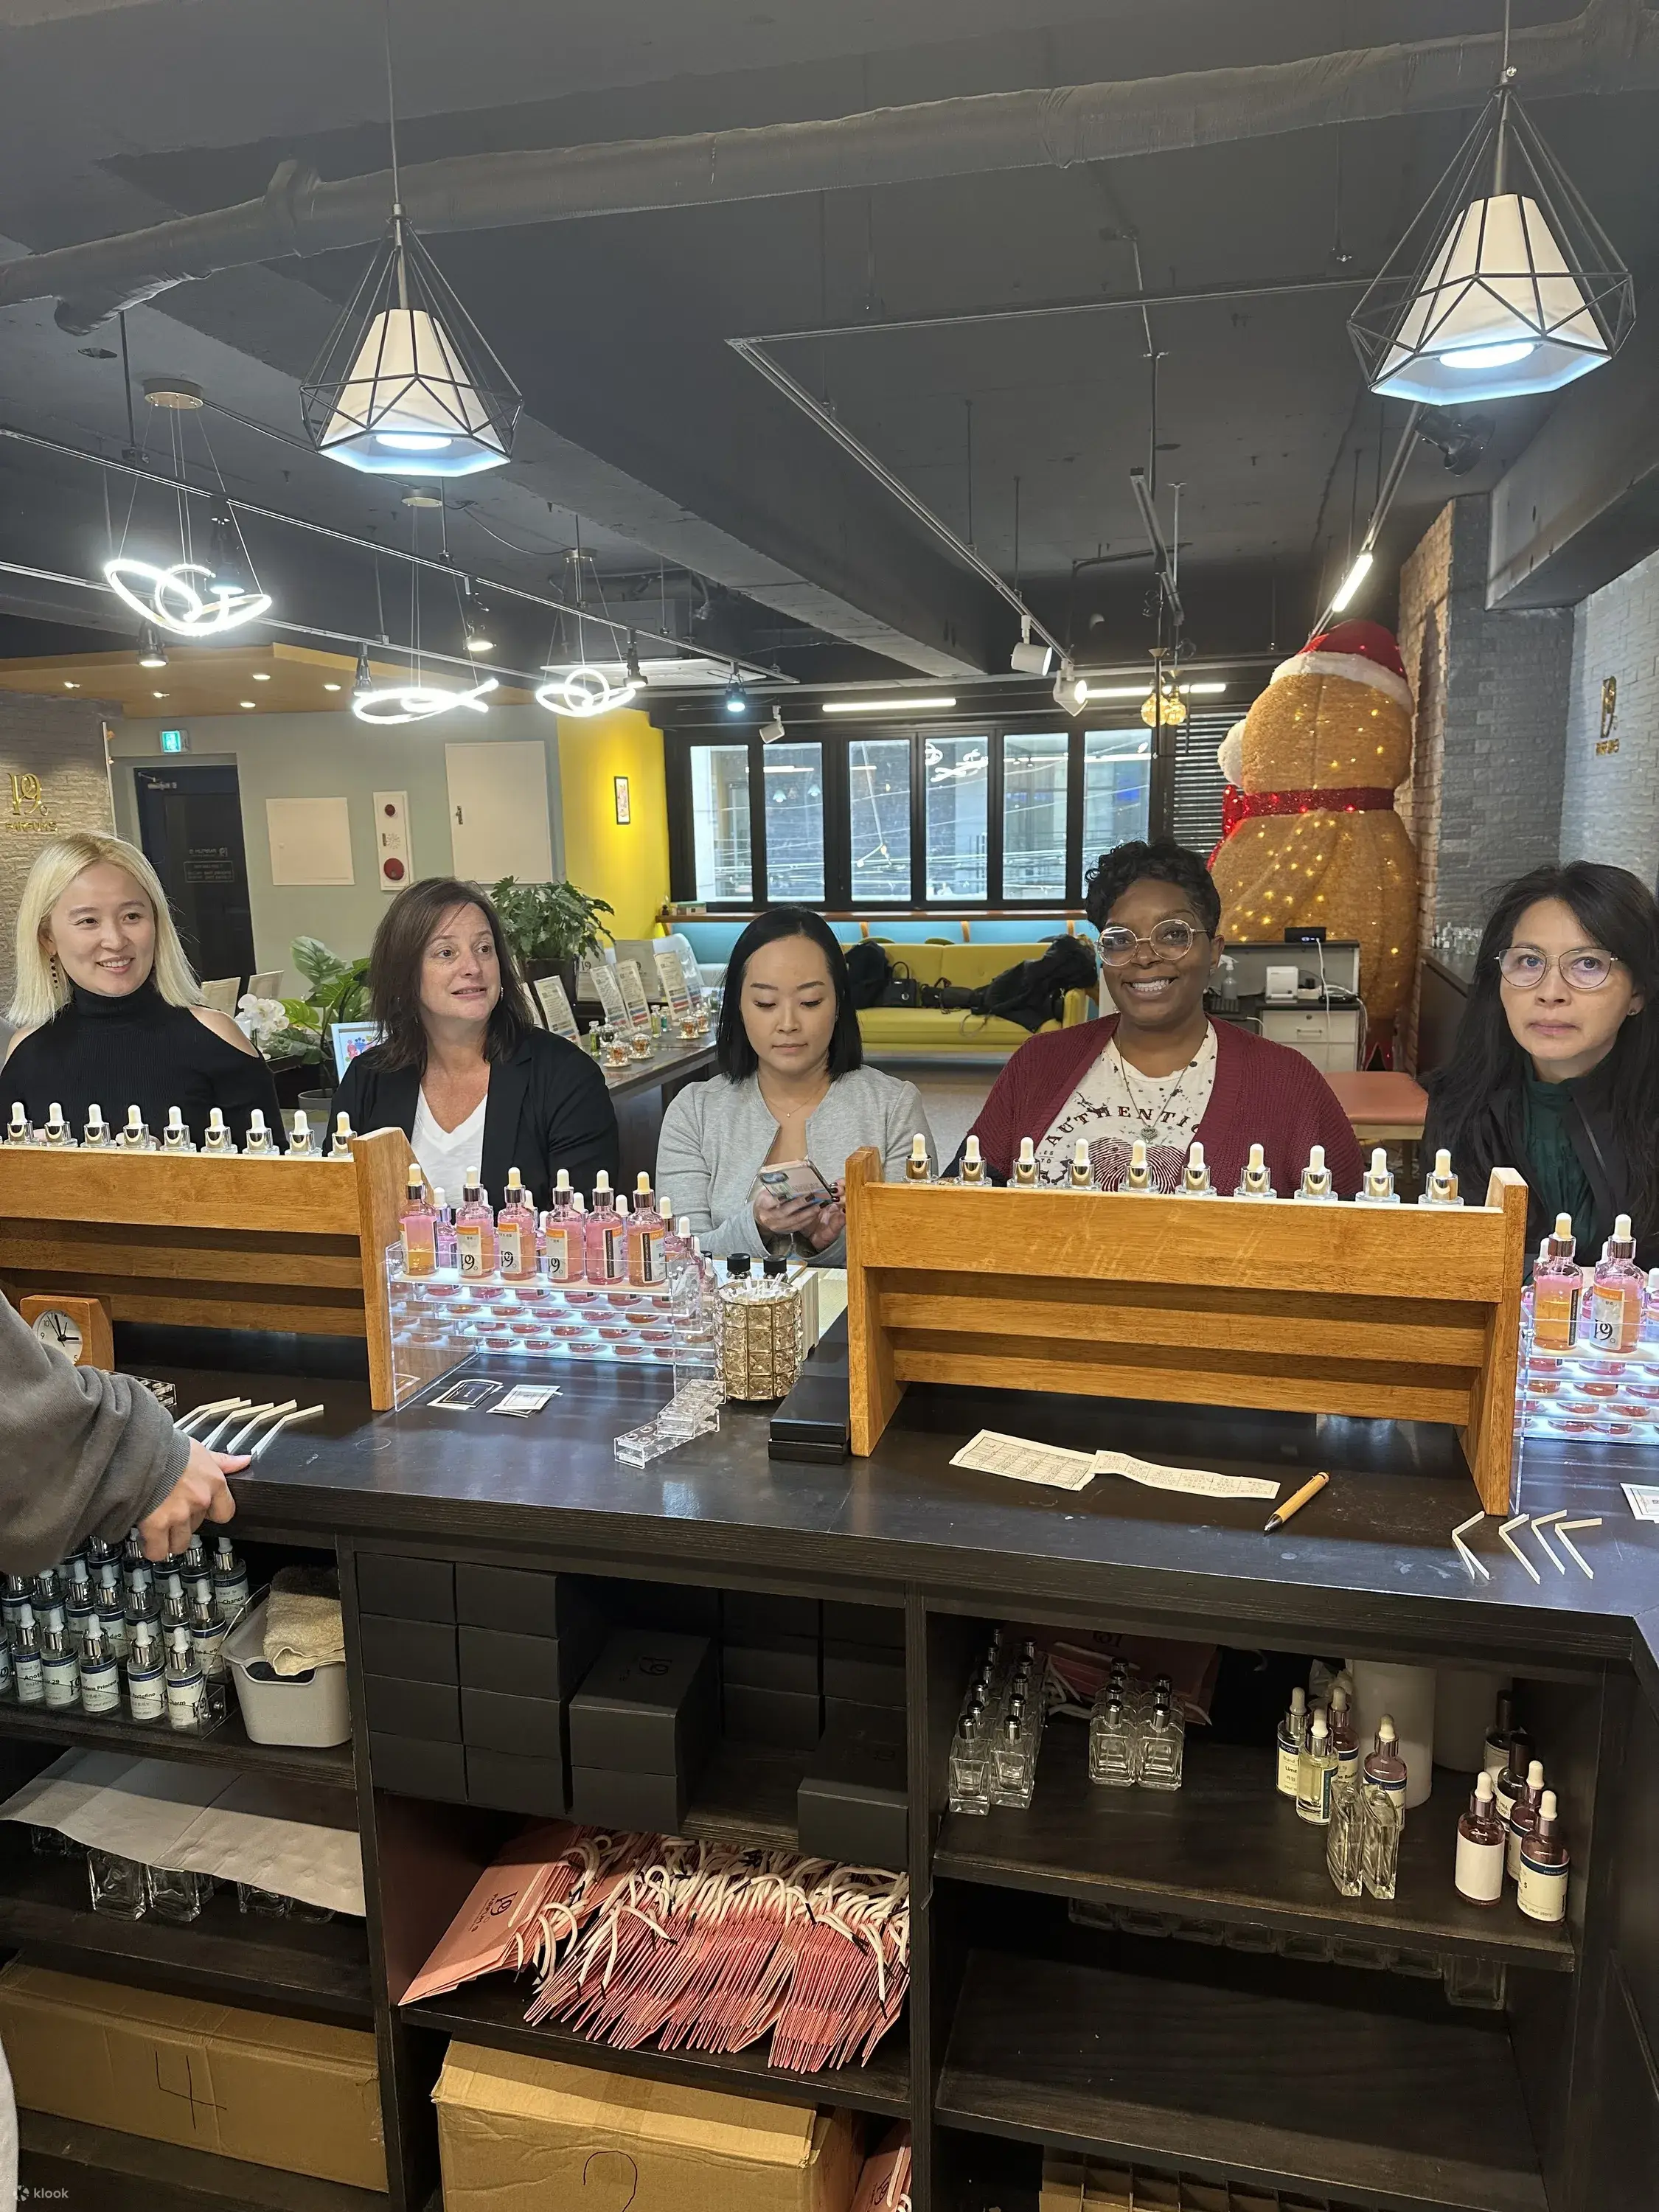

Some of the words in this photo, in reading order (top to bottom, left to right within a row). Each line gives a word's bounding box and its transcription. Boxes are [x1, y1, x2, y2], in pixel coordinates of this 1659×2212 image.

[461, 1253, 475, 1270] 19
[501, 1251, 514, 1267] 19
[1595, 1319, 1613, 1340] 19
[73, 1354, 78, 1363] 5
[24, 1671, 44, 1681] Anoth
[155, 2050, 227, 2129] 4
